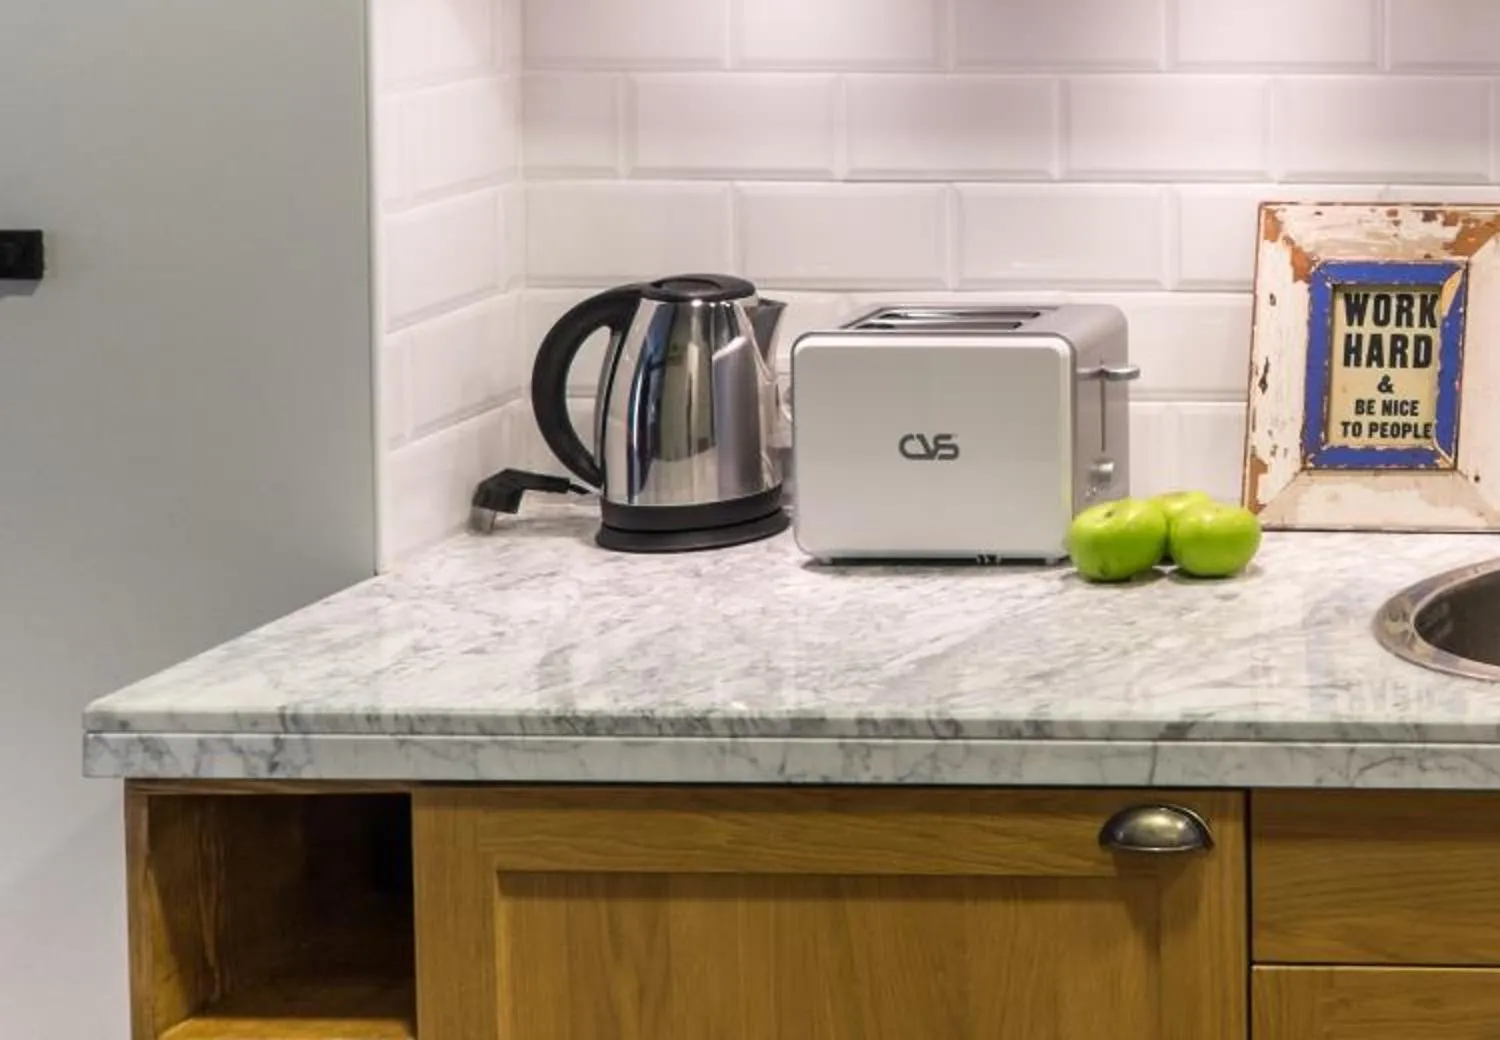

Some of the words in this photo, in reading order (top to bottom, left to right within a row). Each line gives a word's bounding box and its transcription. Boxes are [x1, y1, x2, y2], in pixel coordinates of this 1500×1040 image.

[1343, 293, 1440, 329] WORK
[1343, 333, 1433, 369] HARD
[1377, 374, 1395, 394] &
[1354, 399, 1376, 416] BE
[1381, 399, 1420, 417] NICE
[1341, 421, 1363, 438] TO
[1368, 421, 1433, 440] PEOPLE
[898, 433, 960, 461] CVS
